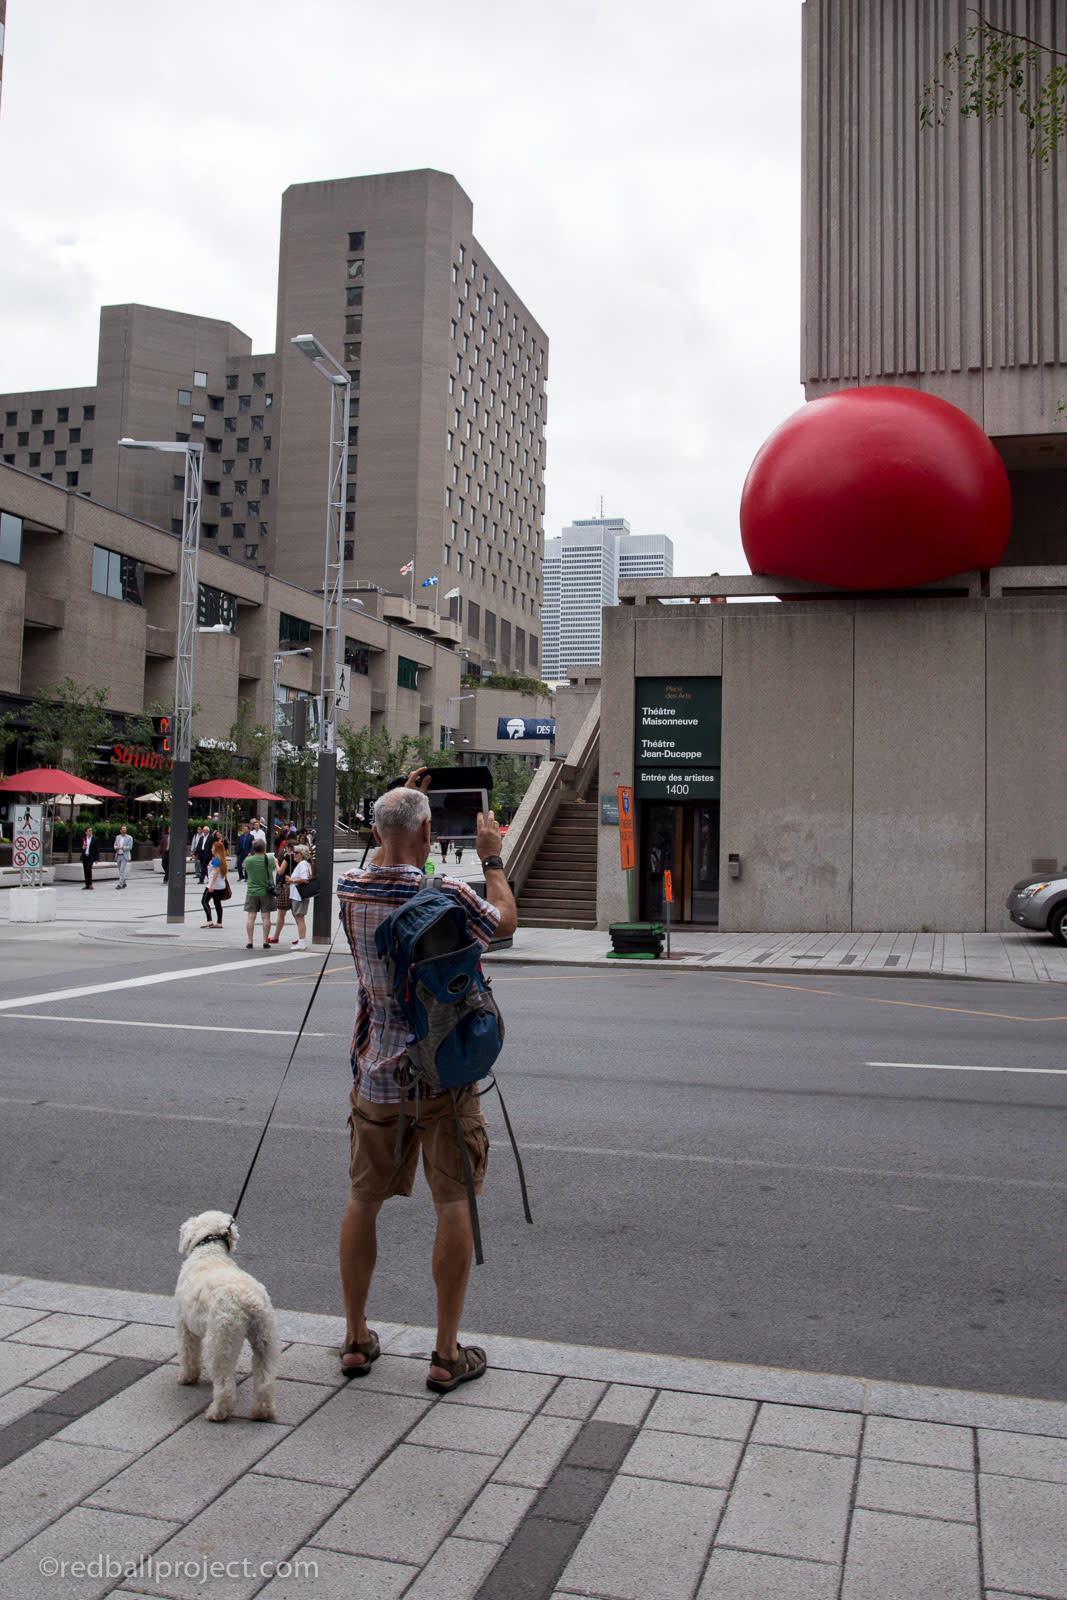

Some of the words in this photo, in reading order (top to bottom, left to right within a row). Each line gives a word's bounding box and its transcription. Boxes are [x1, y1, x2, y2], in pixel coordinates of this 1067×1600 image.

[642, 707, 676, 715] Théâtre
[642, 717, 699, 726] Maisonneuve
[536, 725, 551, 735] DES
[641, 739, 676, 748] Théâtre
[641, 750, 702, 759] Jean-Duceppe
[641, 773, 667, 782] Entrée
[668, 773, 683, 782] des
[684, 773, 714, 782] artistes
[665, 784, 690, 795] 1400
